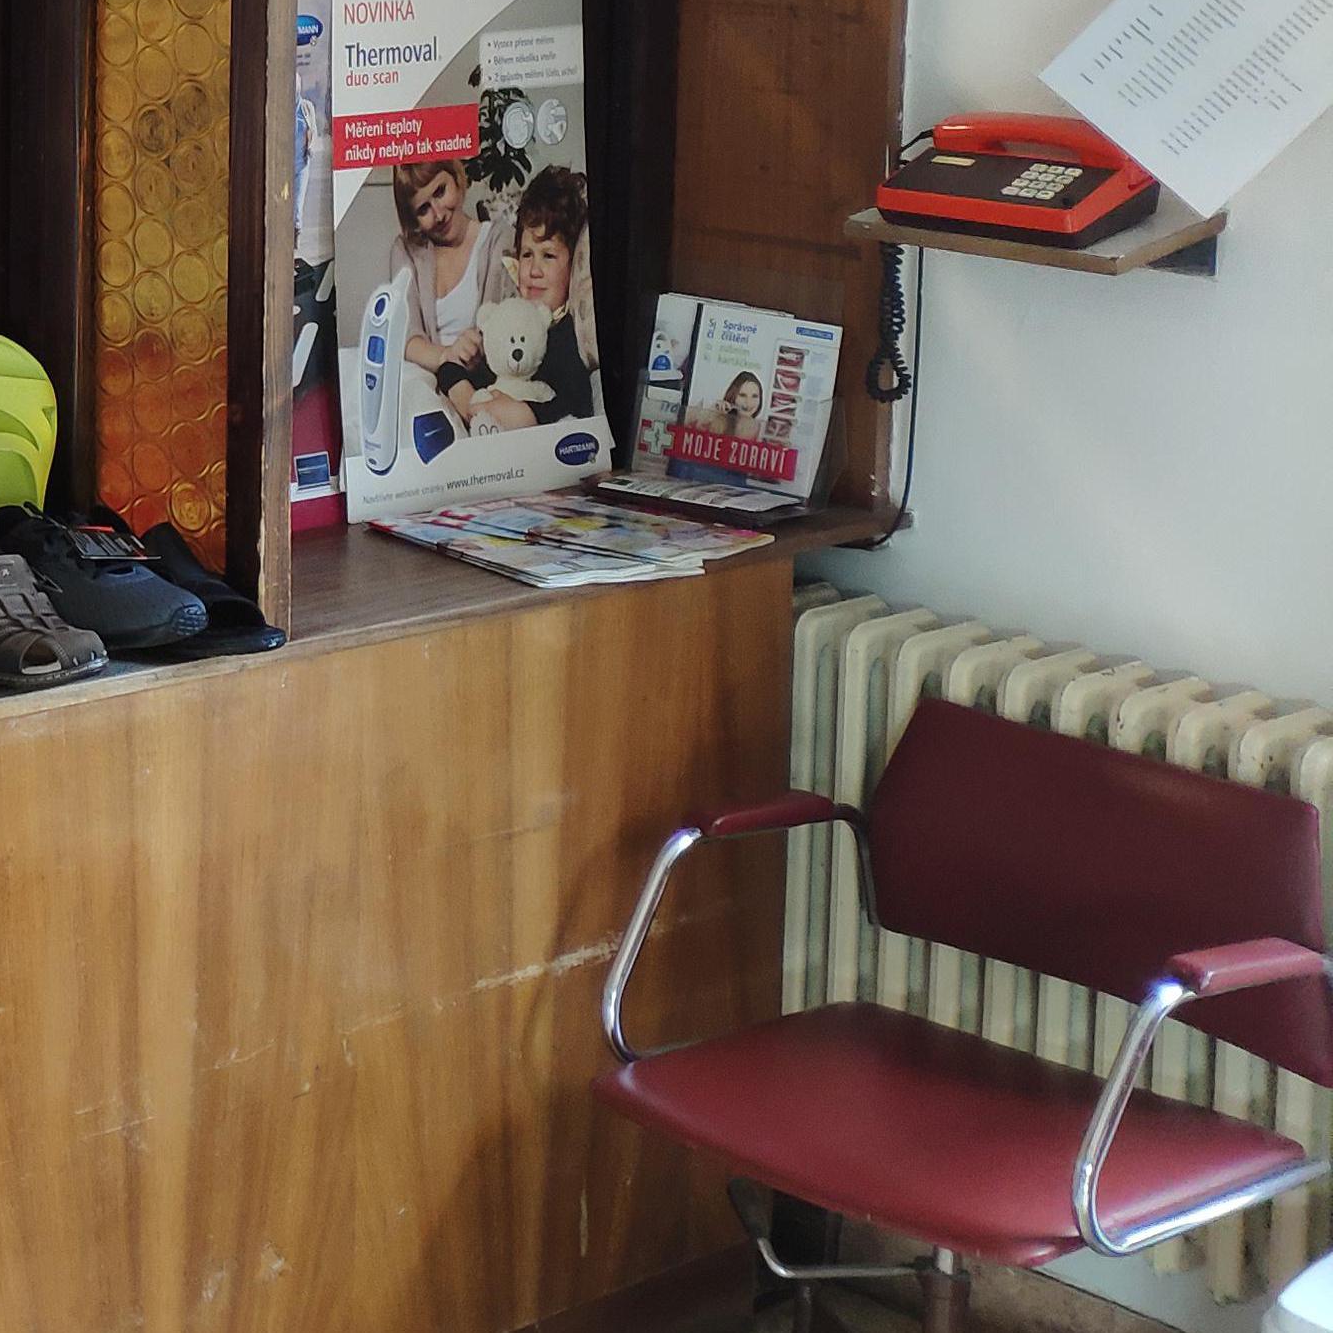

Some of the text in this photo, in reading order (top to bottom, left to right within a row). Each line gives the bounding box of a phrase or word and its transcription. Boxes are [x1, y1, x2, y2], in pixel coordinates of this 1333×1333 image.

[344, 0, 415, 25] NOVINKA
[345, 36, 438, 67] Thermoval
[346, 70, 399, 87] duo scan
[345, 118, 422, 139] Měření teploty
[345, 133, 472, 162] nikdy nebylo tak snadné
[559, 442, 596, 456] HARTMANN
[683, 432, 788, 474] MOJE ZDRAVÍ
[447, 468, 525, 490] www.thermoval.cz
